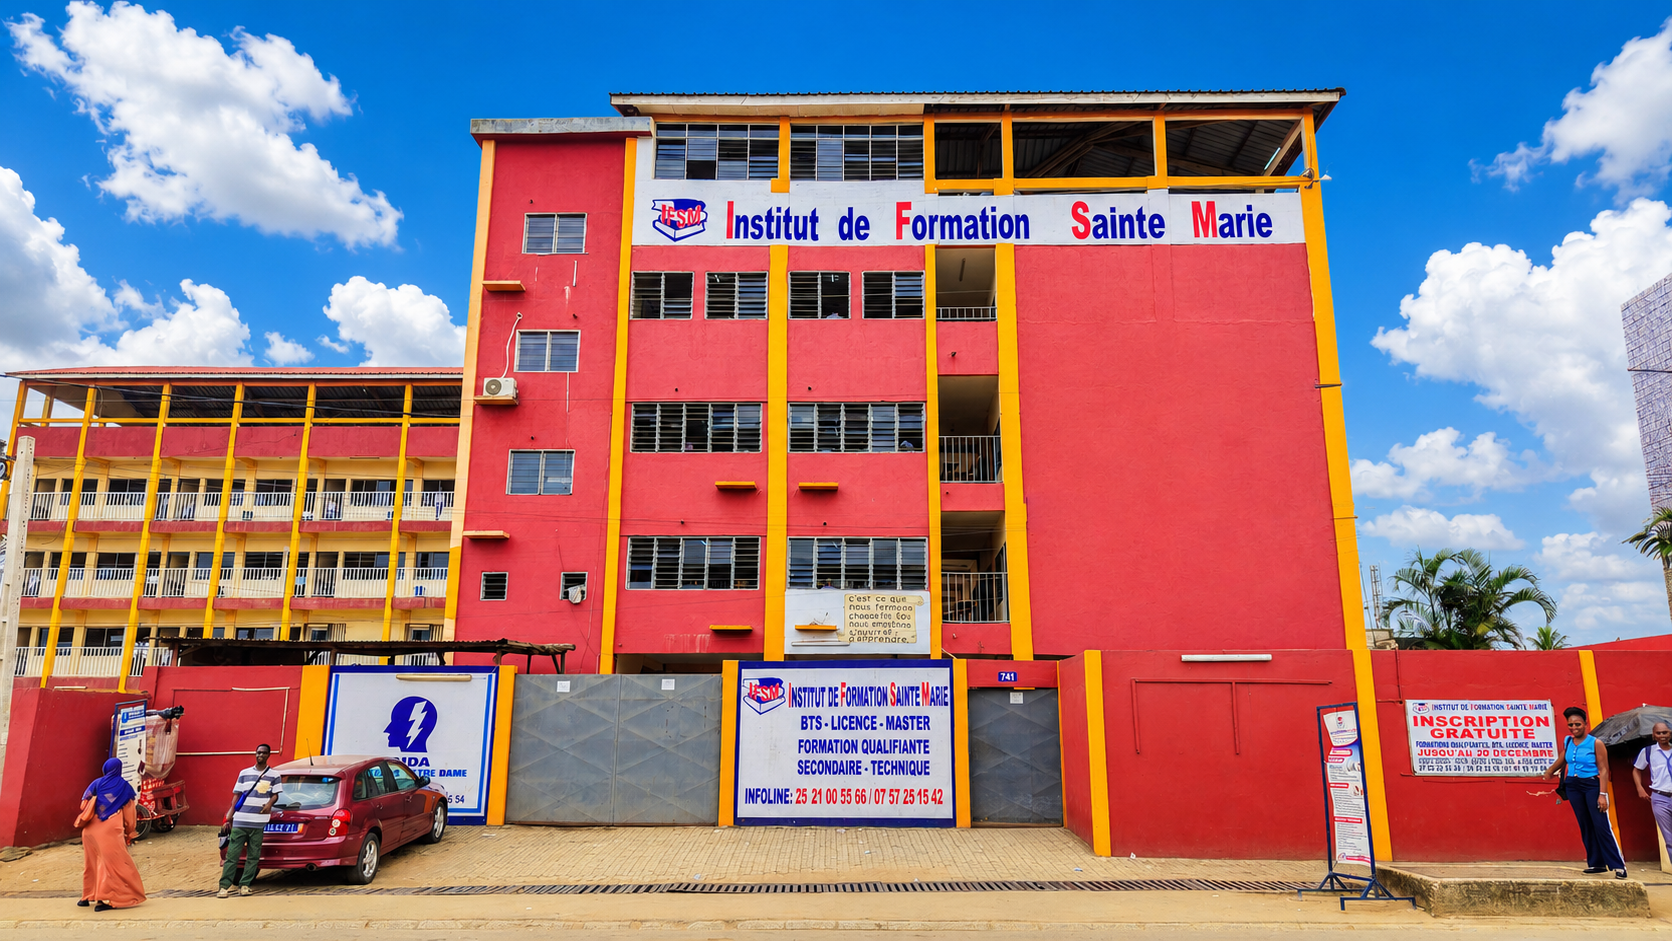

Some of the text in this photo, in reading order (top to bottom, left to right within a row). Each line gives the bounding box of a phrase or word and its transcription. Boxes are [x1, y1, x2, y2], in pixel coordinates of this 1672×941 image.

[661, 203, 703, 228] IFSM
[726, 200, 1273, 241] Institut de Formation Sainte Marie
[1000, 672, 1015, 681] 741
[788, 681, 949, 708] INSTITUT DE FORMATION SAINTE MARIE
[800, 715, 823, 731] BTS
[831, 715, 877, 731] LICENCE
[885, 715, 931, 731] MASTER
[1412, 715, 1550, 728] INSCRIPTION
[1430, 727, 1536, 740] GRATUITE
[798, 739, 930, 755] FORMATION QUALIFIANTE
[1417, 748, 1473, 758] JUSQU'AU
[1493, 749, 1554, 758] DECEMBRE
[393, 756, 430, 767] IDA
[797, 759, 862, 775] SECONDAIRE
[870, 760, 930, 776] TECHNIQUE
[438, 769, 468, 778] DAME
[744, 788, 793, 805] INFOLINE:
[795, 788, 808, 805] 25
[811, 788, 823, 805] 21
[825, 788, 838, 805] 00
[840, 788, 852, 805] 55
[854, 788, 867, 805] 66
[874, 788, 886, 805] 07
[888, 788, 901, 805] 57
[902, 788, 915, 805] 25
[917, 788, 929, 805] 15
[930, 788, 944, 805] 42
